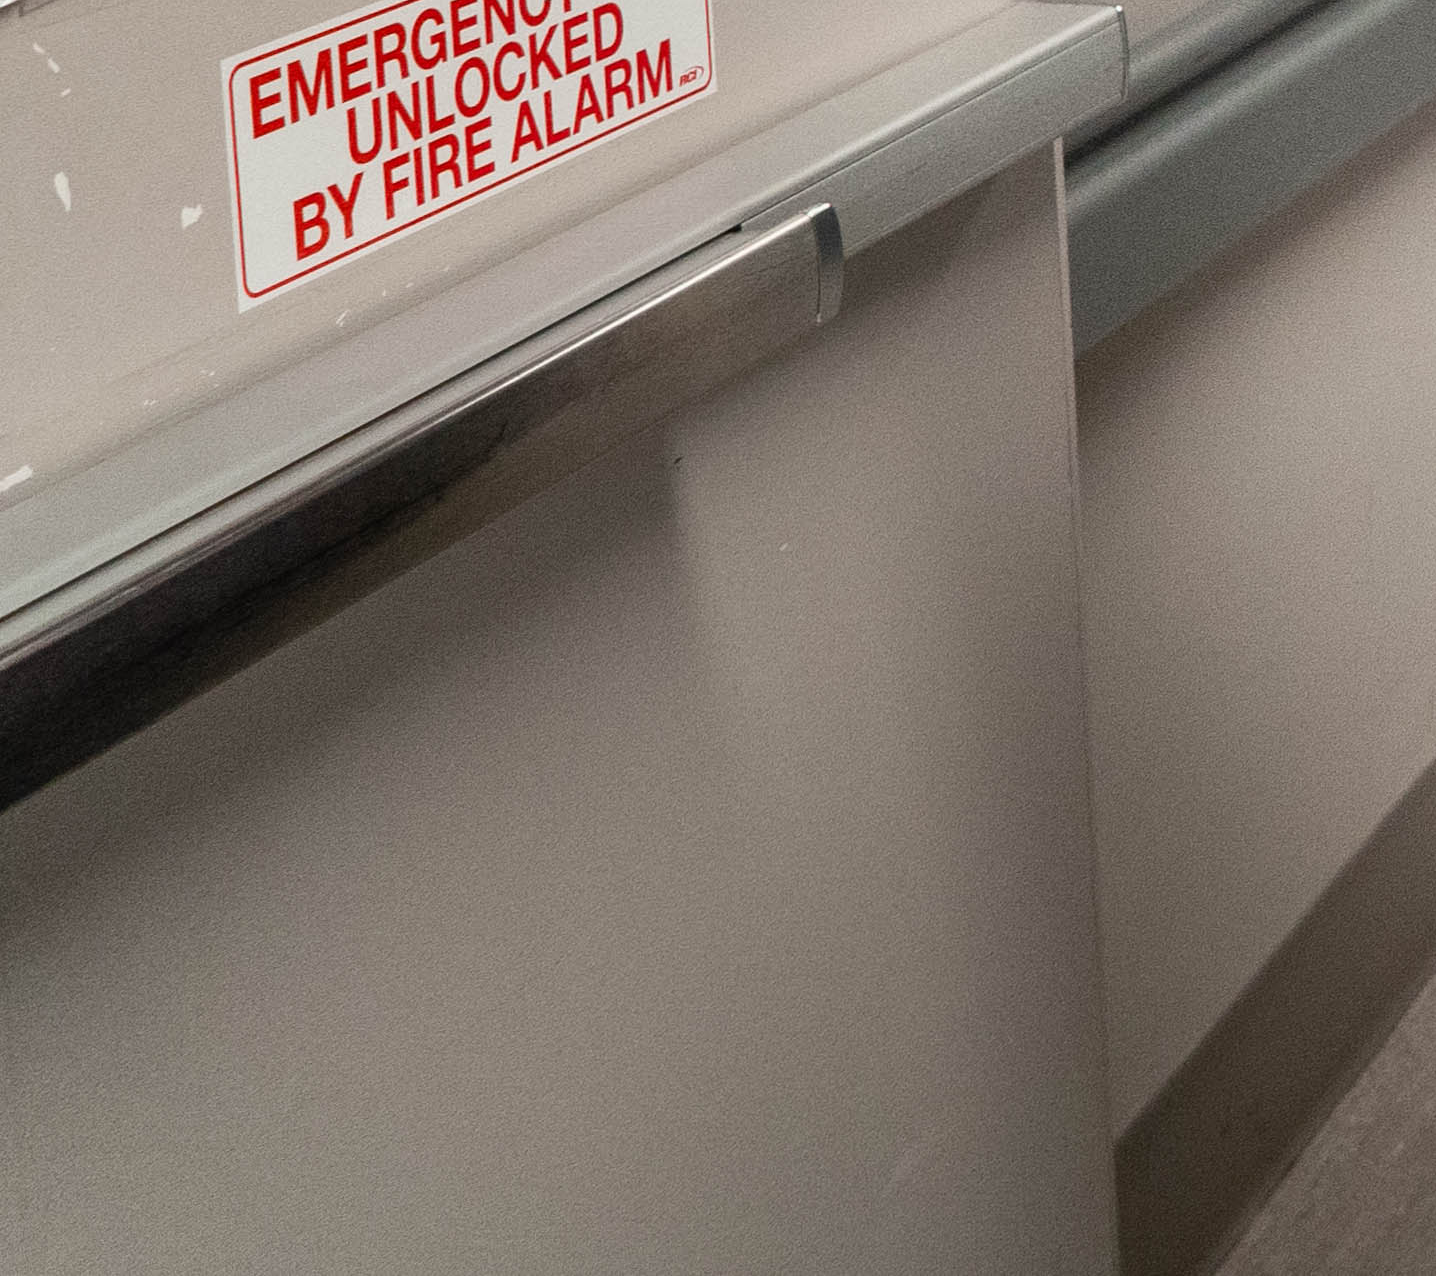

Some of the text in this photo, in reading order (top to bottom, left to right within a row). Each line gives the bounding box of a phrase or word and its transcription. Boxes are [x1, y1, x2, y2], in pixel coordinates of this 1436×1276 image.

[293, 41, 673, 263] BY FIRE ALARM
[347, 3, 624, 165] UNLOCKED
